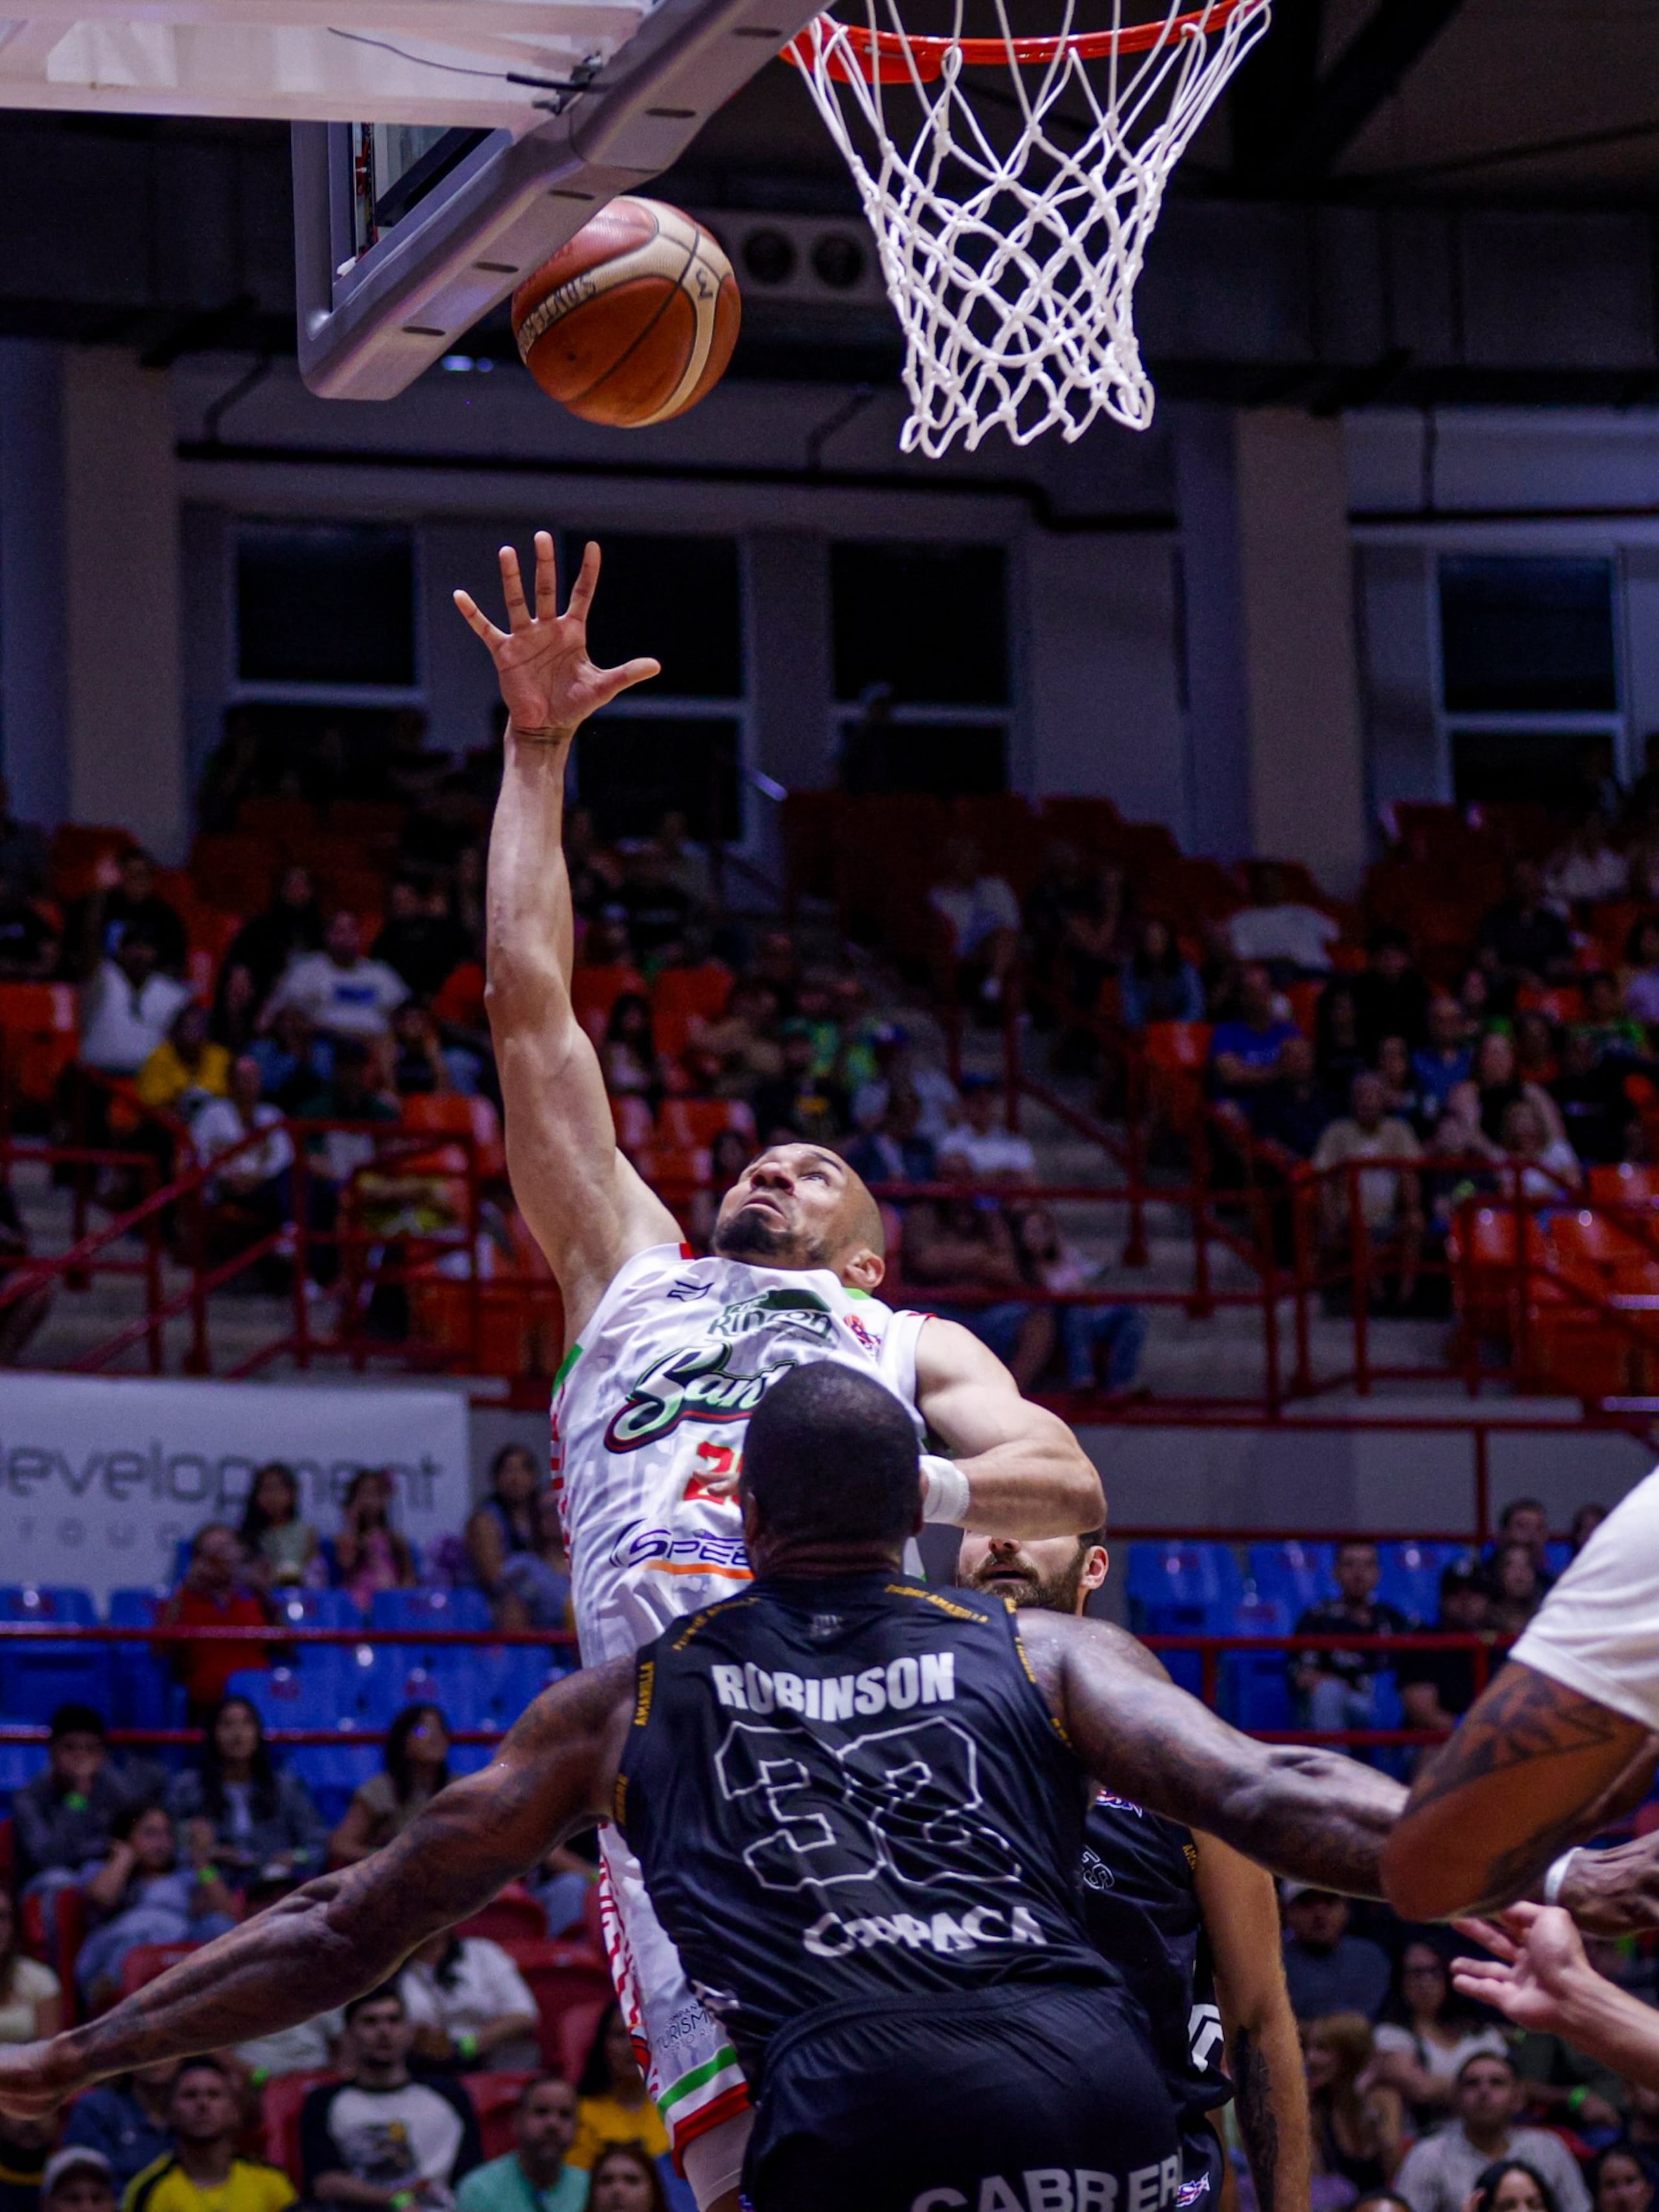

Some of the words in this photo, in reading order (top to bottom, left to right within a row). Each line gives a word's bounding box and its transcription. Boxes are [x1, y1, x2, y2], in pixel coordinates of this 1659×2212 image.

[682, 1440, 743, 1506] 2
[711, 1652, 955, 1721] ROBINSON
[655, 2010, 709, 2053] TURISM
